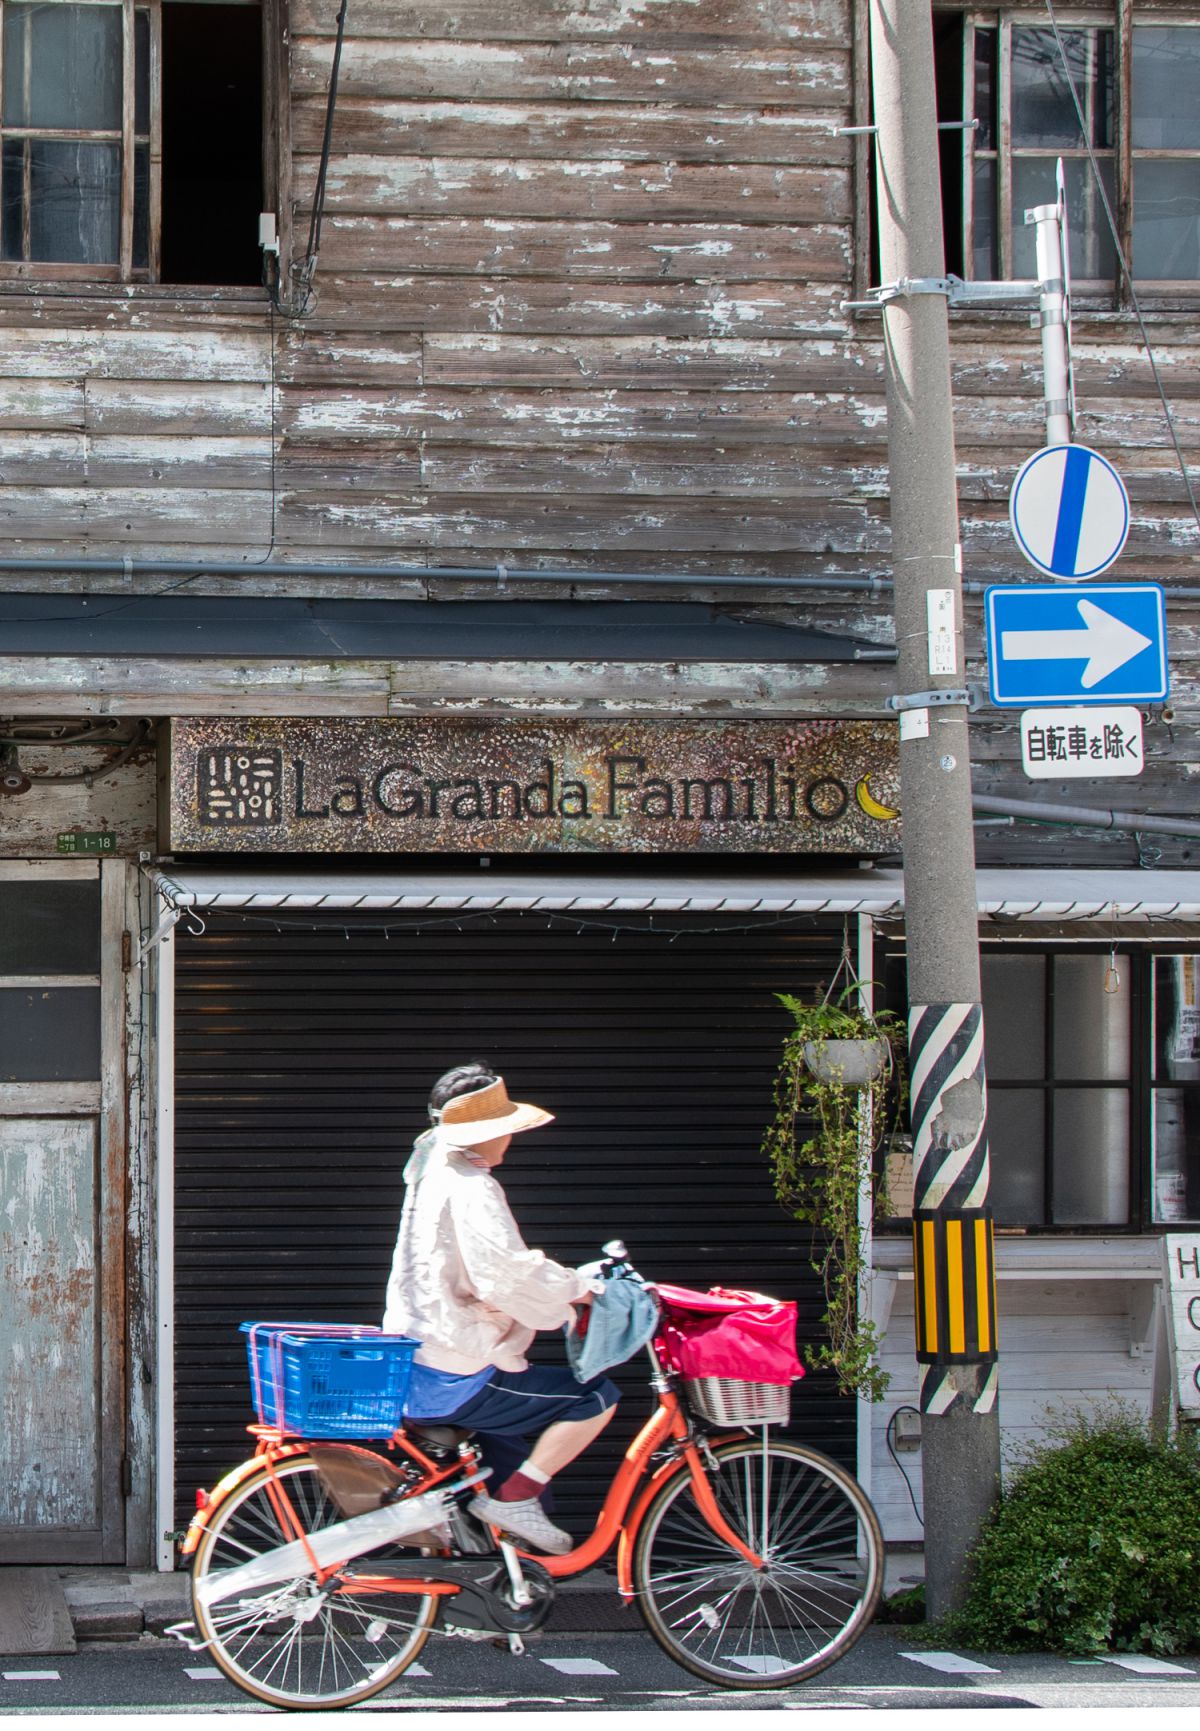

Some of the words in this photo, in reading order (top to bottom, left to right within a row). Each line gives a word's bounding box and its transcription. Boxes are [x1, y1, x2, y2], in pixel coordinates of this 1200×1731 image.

[1028, 725, 1138, 761] 自転車を除く
[603, 755, 849, 822] Familio
[84, 838, 111, 848] 1-18
